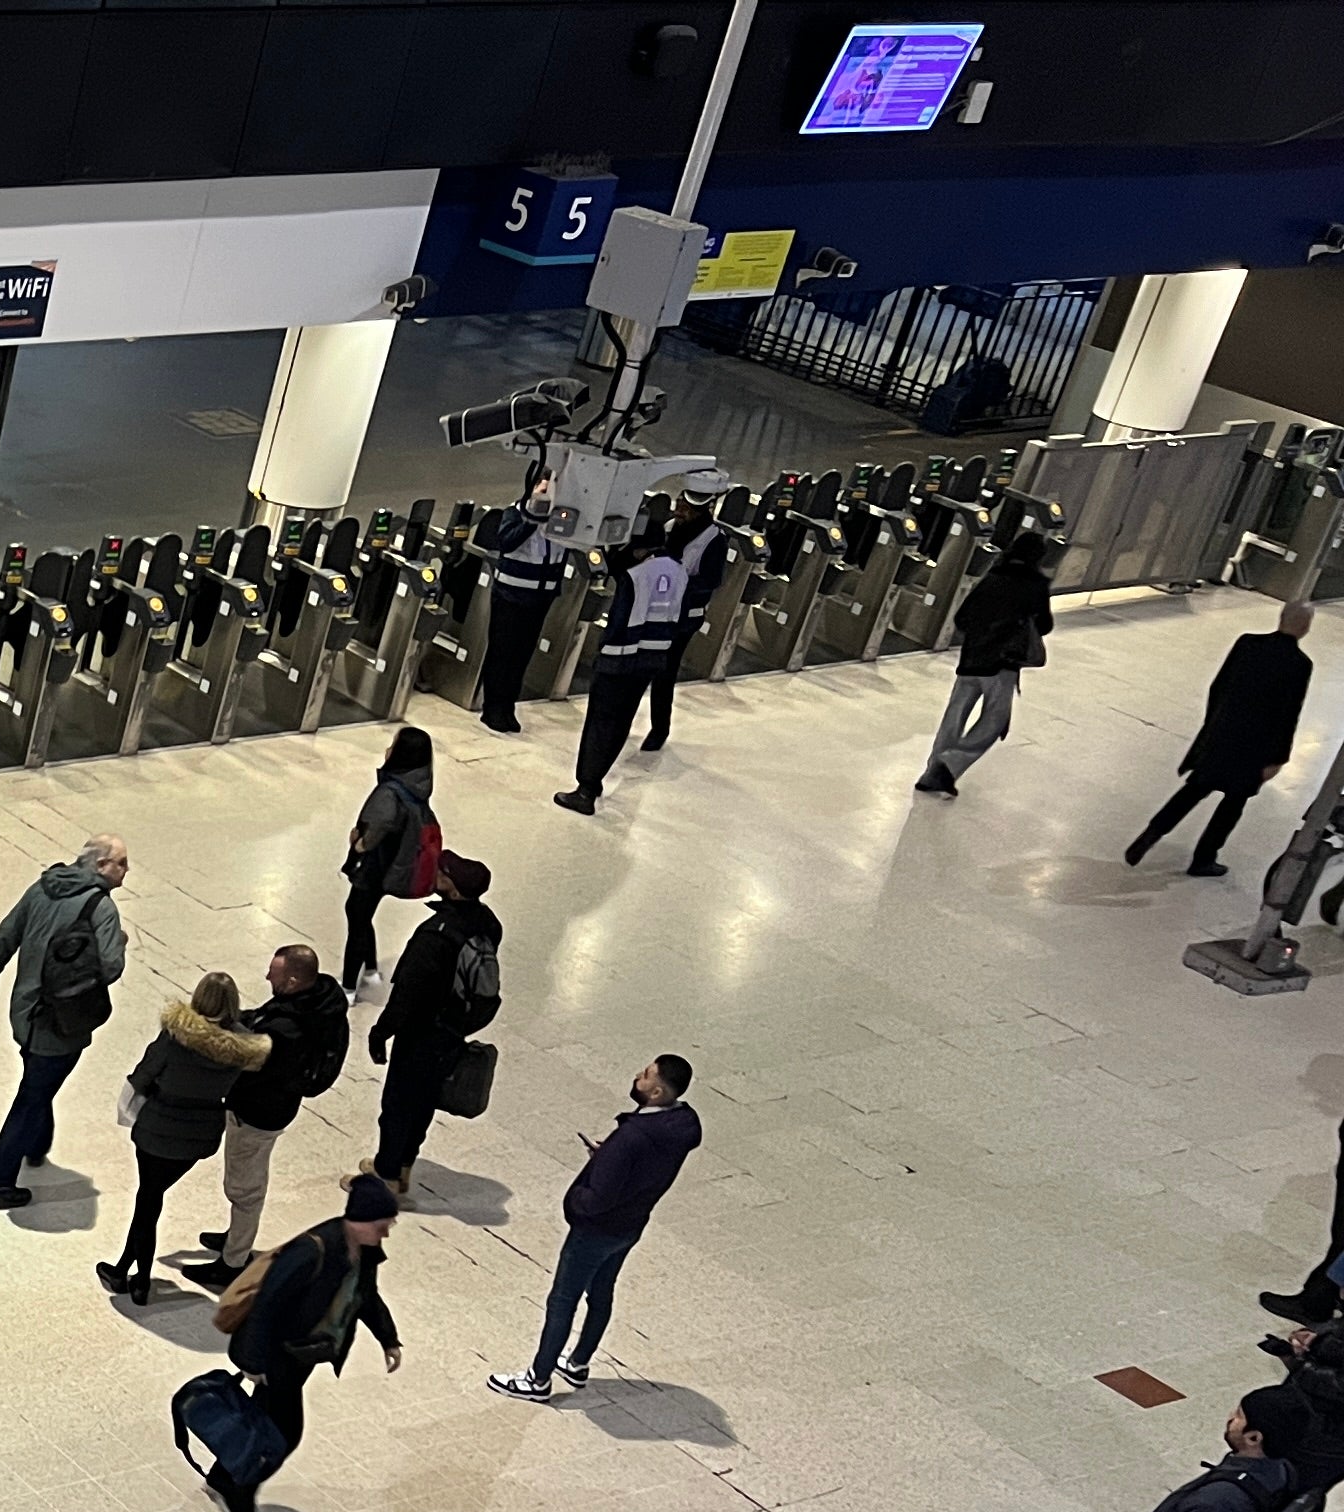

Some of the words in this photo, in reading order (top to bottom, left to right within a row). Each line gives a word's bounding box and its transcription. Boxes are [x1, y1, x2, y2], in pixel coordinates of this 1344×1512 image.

[505, 187, 534, 232] 5
[562, 196, 593, 240] 5
[8, 277, 50, 299] WiFi
